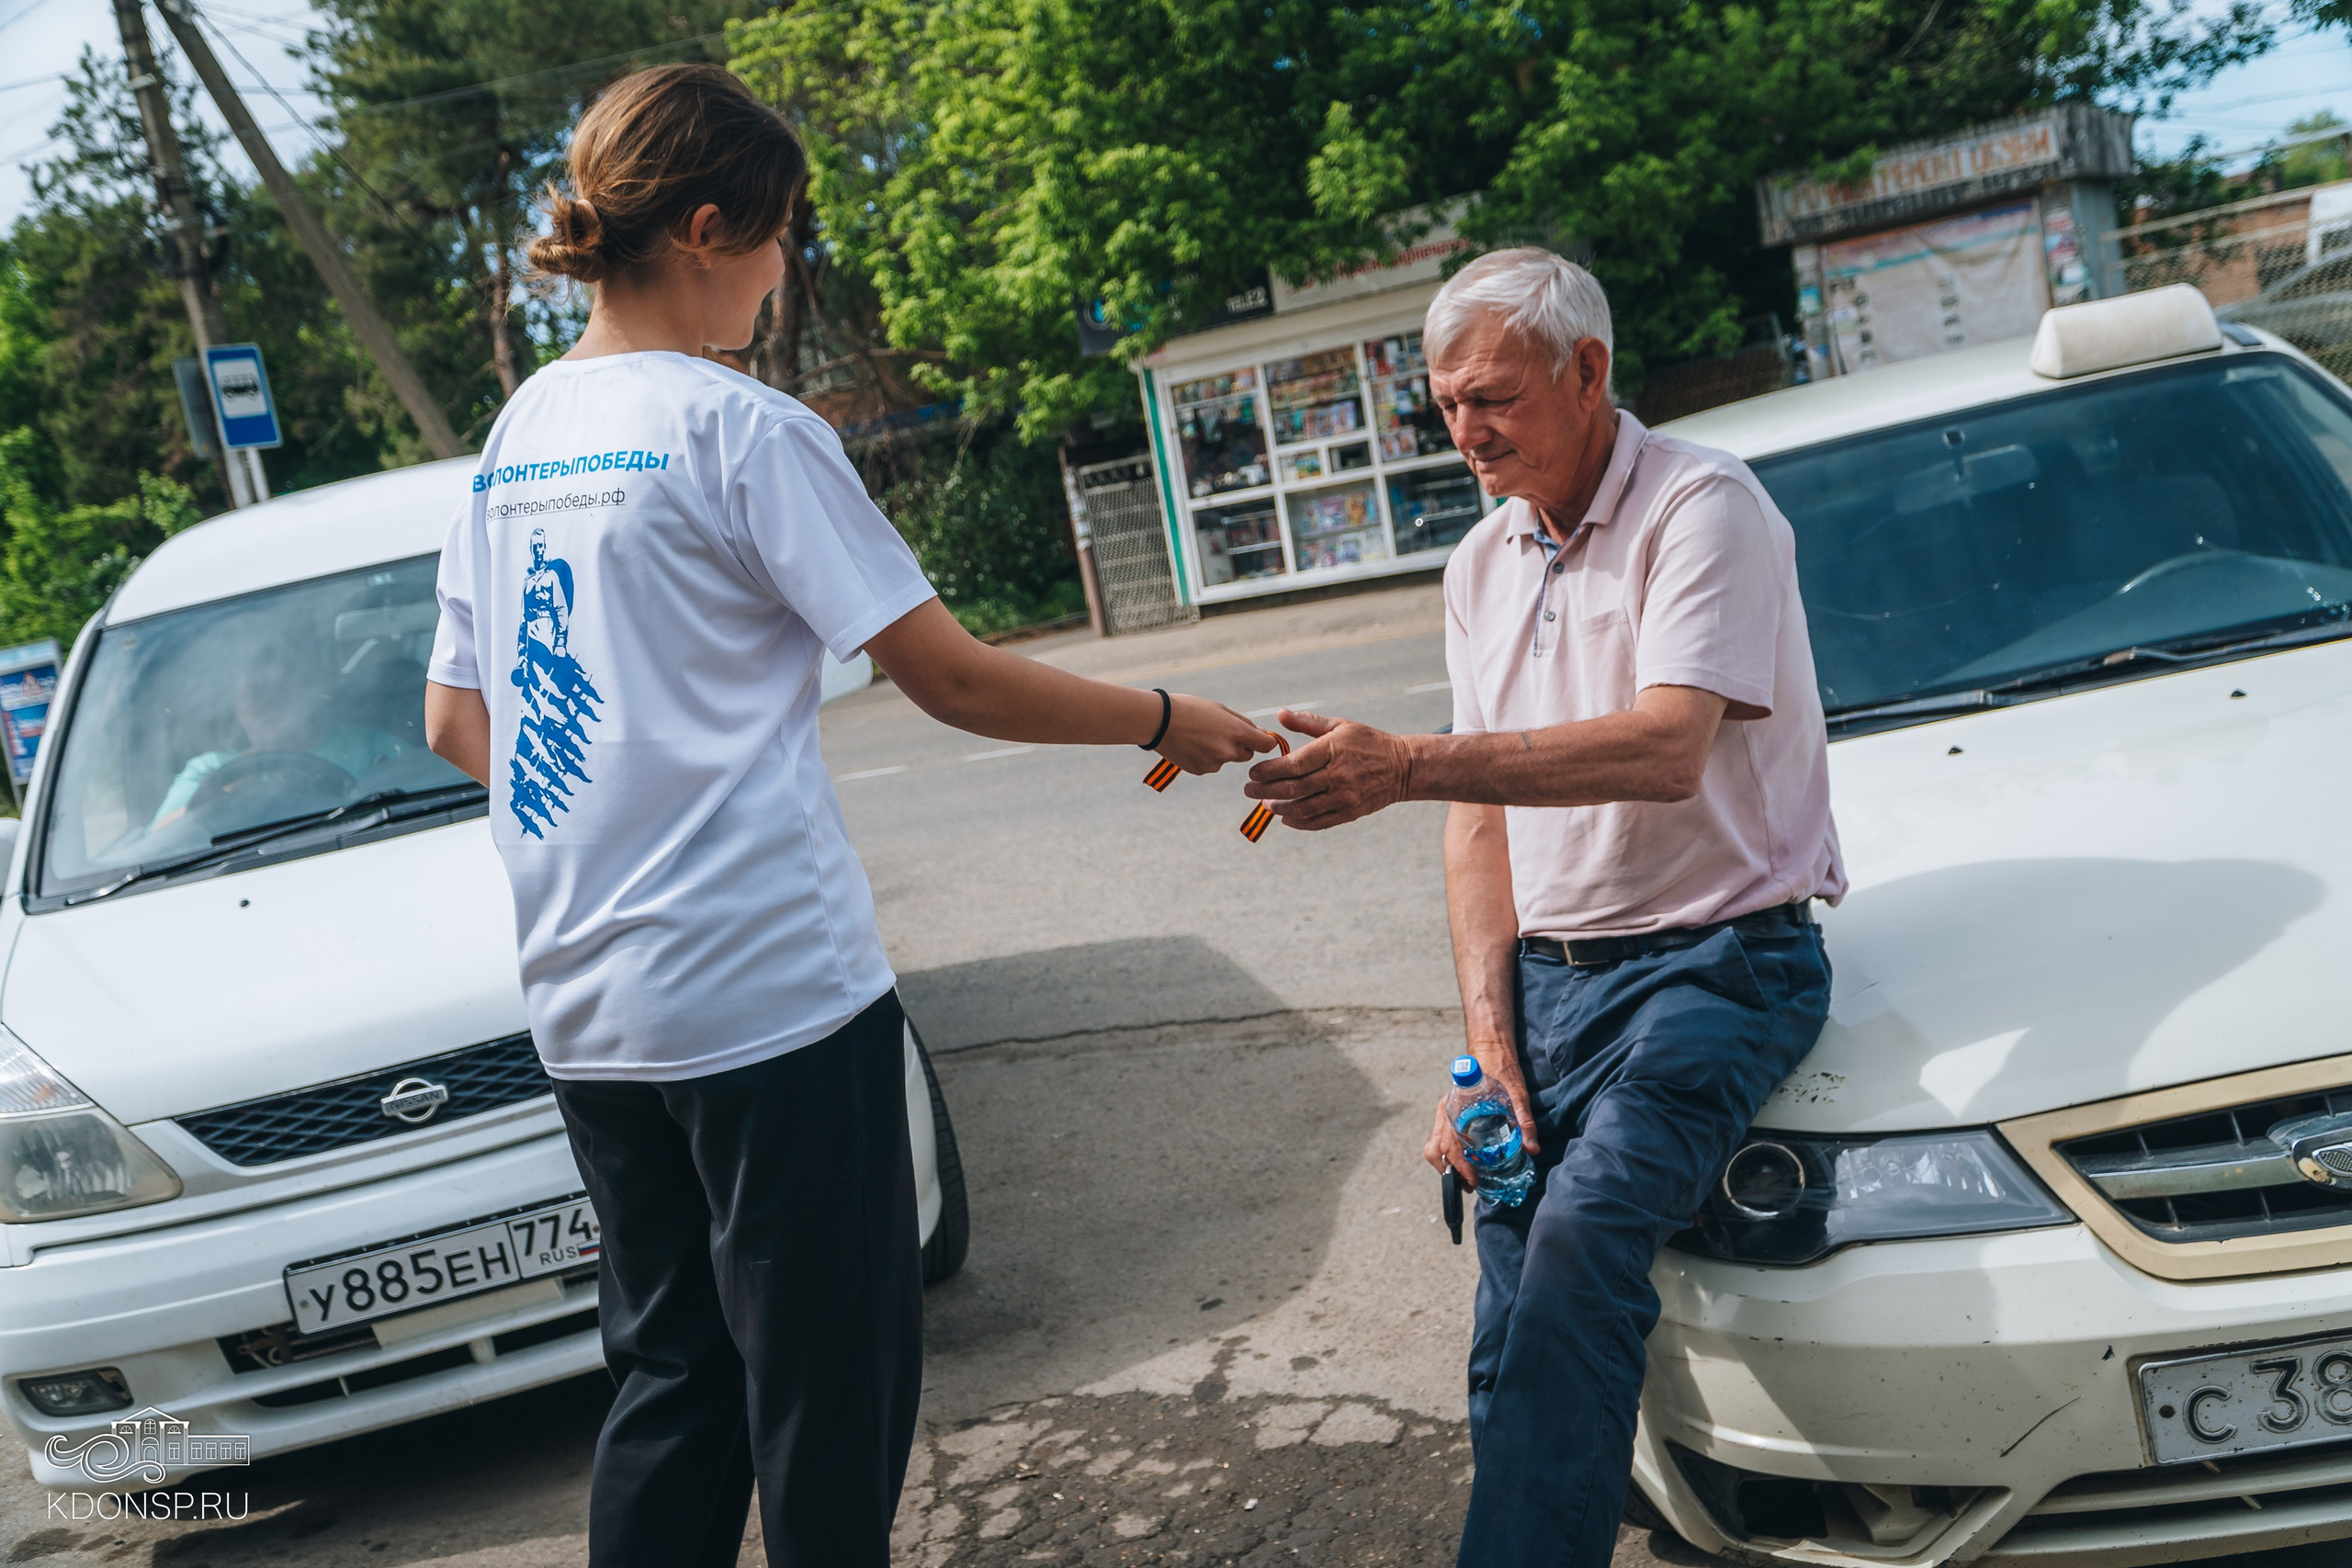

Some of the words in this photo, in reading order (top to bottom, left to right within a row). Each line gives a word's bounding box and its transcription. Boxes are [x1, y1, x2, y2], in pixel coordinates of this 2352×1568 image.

[390, 1091, 440, 1109] NISSAN
[514, 1208, 593, 1257] 774
[539, 1247, 578, 1266] RUS
